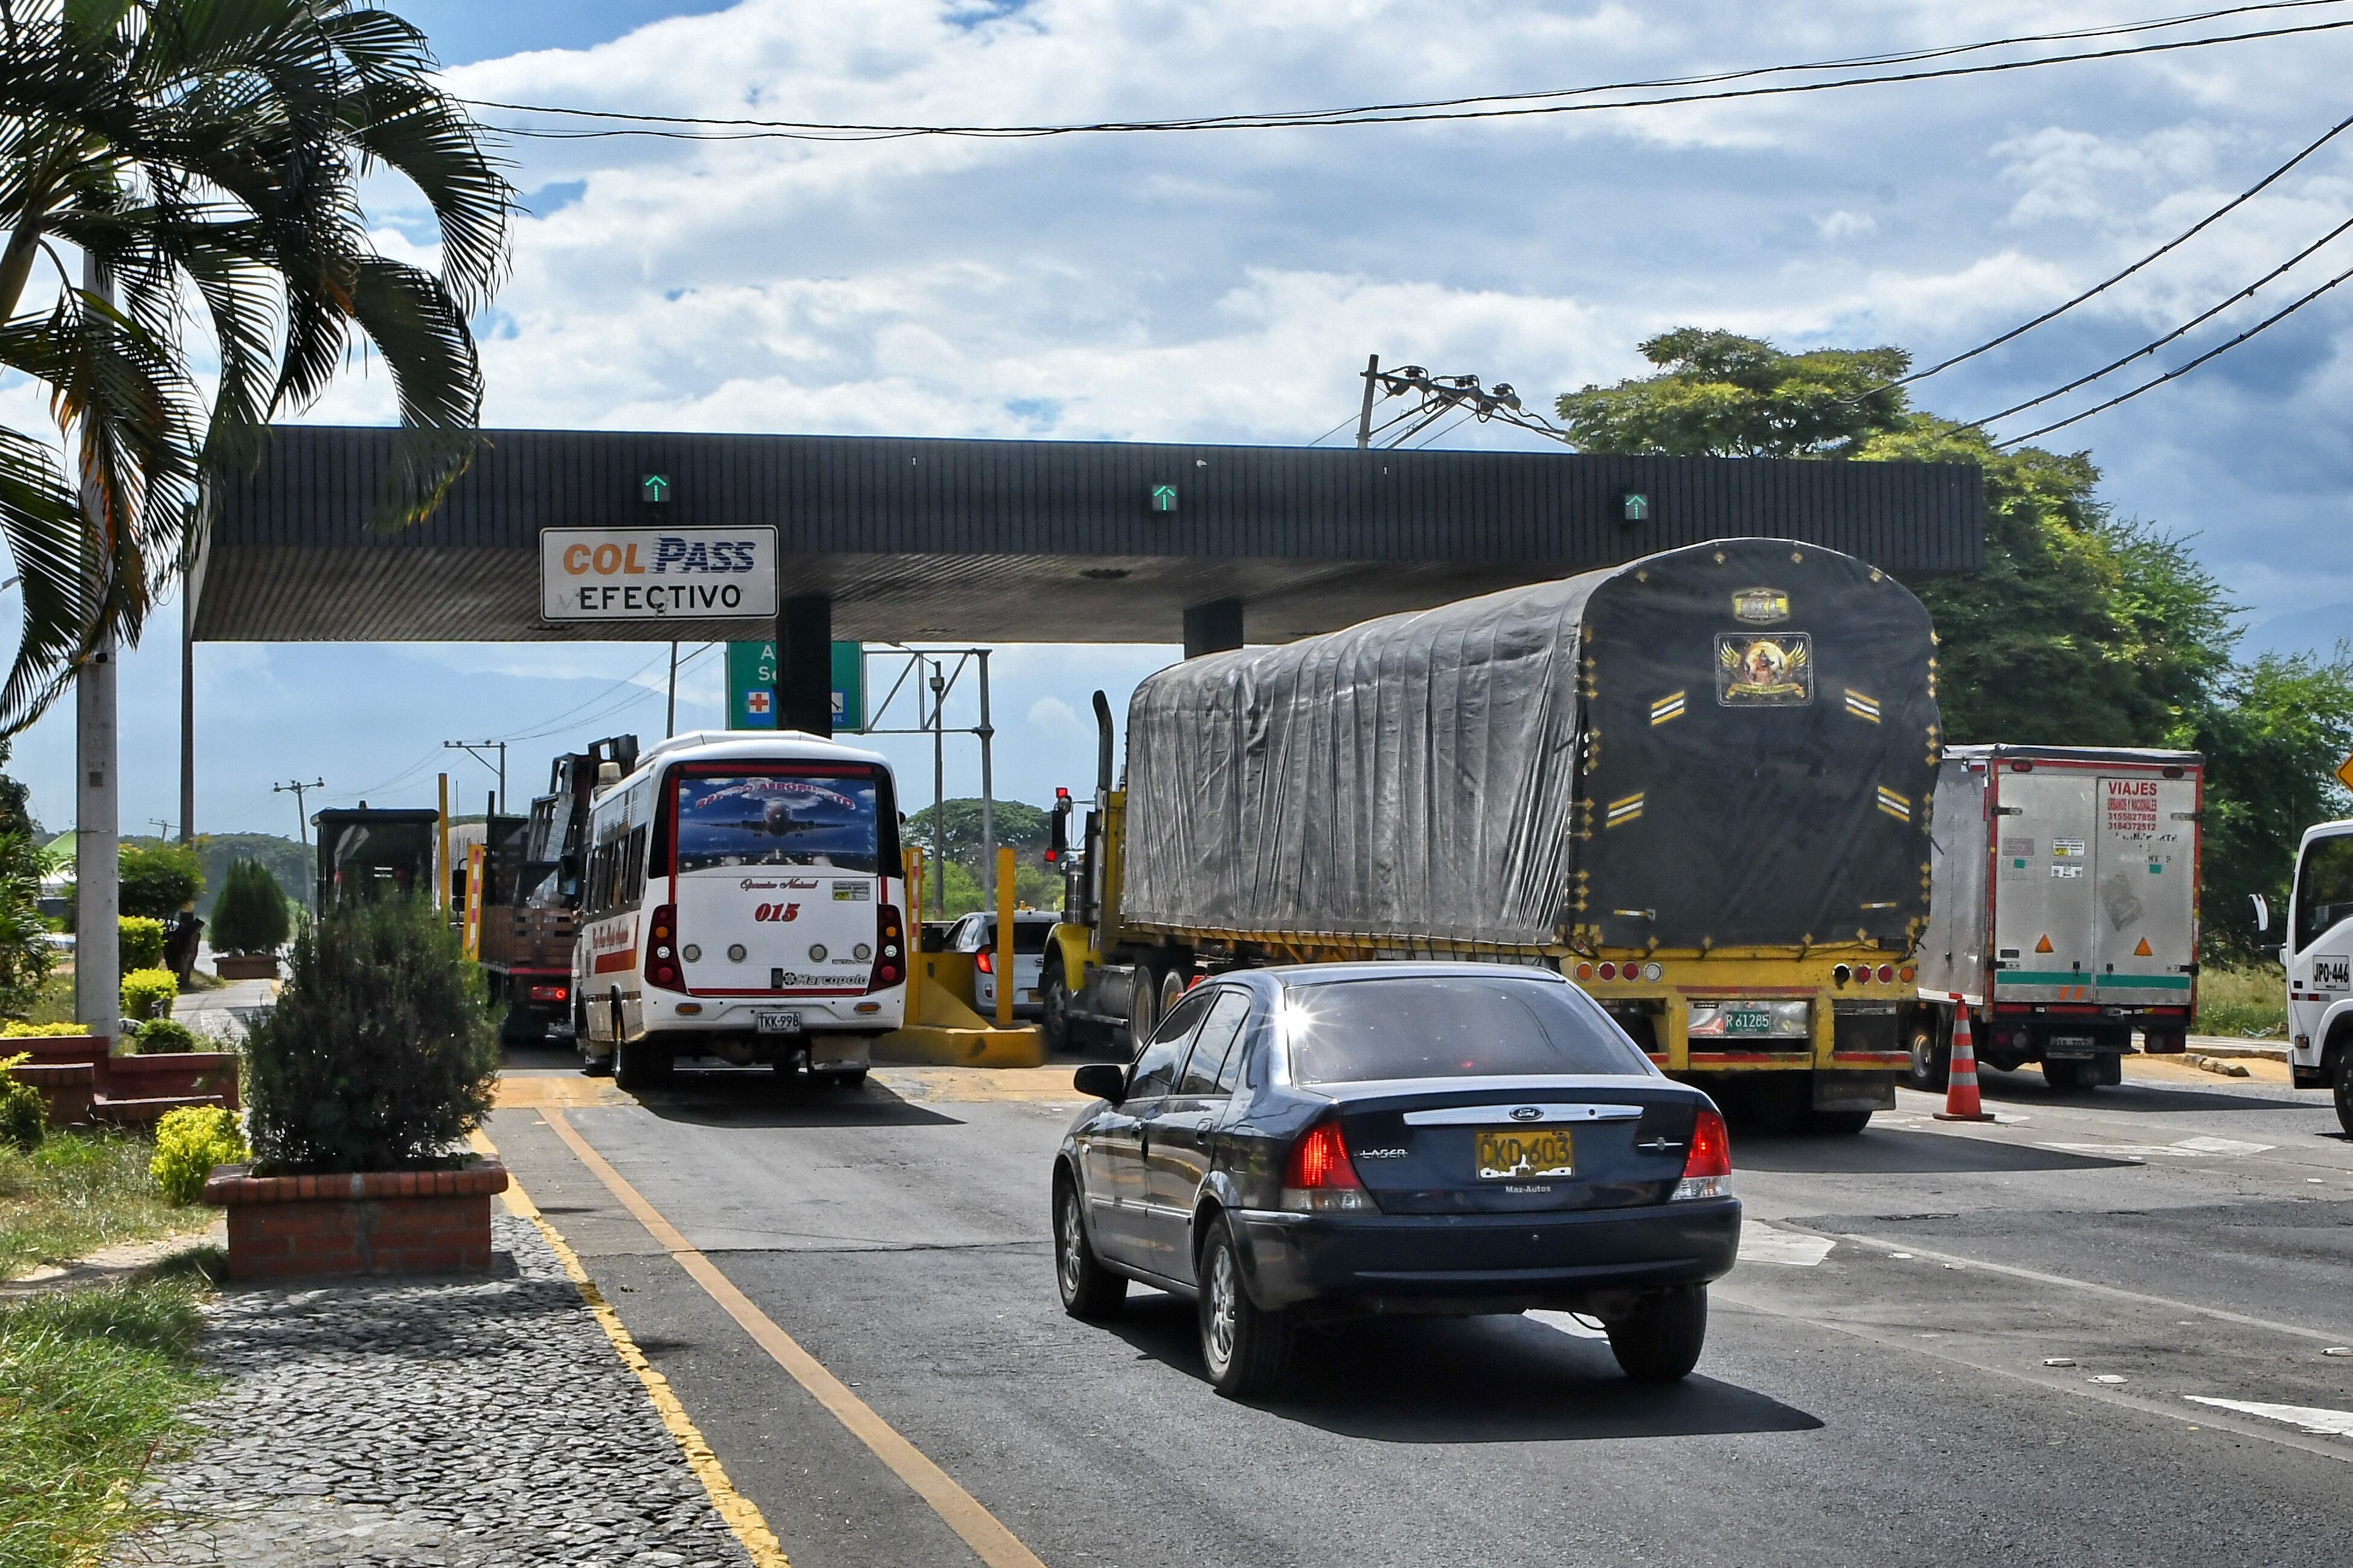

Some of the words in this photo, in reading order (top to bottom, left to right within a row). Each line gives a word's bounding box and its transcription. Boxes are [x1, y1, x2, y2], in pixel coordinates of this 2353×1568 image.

[563, 543, 645, 575] COL
[648, 534, 756, 575] PASS
[580, 584, 741, 612] EFECTIVO
[2108, 782, 2157, 796] VIAJES
[755, 903, 801, 923] 015
[2314, 963, 2349, 983] JPO-446
[795, 974, 868, 987] Marcopolo
[759, 1016, 799, 1028] TKK-998
[1735, 1014, 1769, 1028] 61285
[1359, 1149, 1408, 1159] LASER
